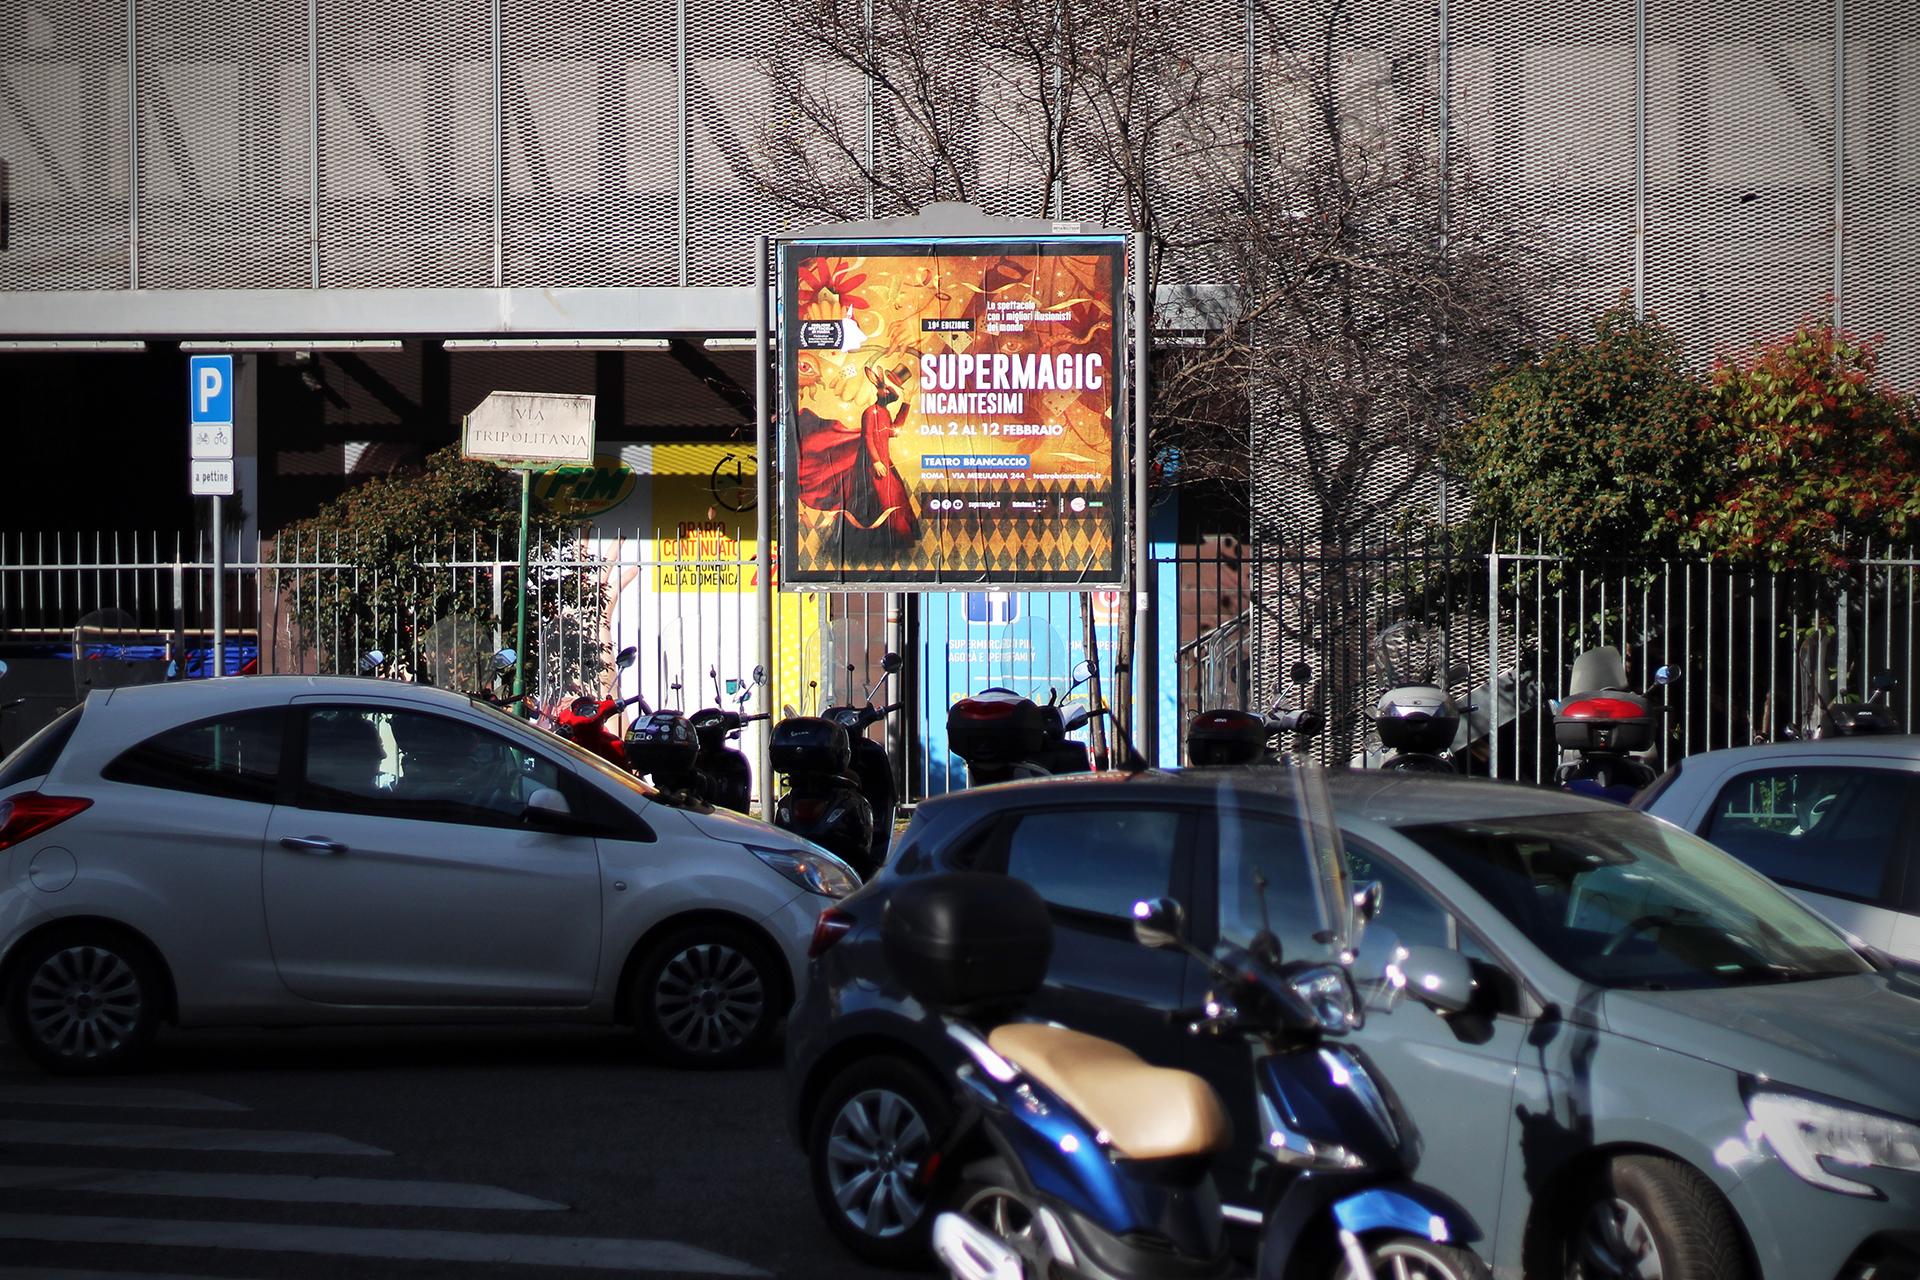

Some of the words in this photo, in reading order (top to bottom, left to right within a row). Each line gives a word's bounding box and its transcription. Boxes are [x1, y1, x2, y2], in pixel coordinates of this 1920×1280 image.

[987, 301, 996, 311] Lo
[997, 301, 1036, 312] spettacolo
[987, 312, 1000, 321] con
[1006, 311, 1034, 323] migliori
[1034, 311, 1072, 321] illusionisti
[941, 320, 970, 330] EDIZIONE
[999, 322, 1024, 332] mondo
[920, 353, 1103, 391] SUPERMAGIC
[200, 367, 223, 413] P
[920, 392, 1024, 415] INCANTESIMI
[515, 408, 545, 421] VIA
[920, 424, 944, 436] DAL
[948, 421, 958, 436] 2
[961, 424, 976, 436] AL
[981, 422, 1000, 436] 12
[1003, 423, 1063, 436] FEBBRAIO
[473, 429, 588, 447] TRIPOLITANIA
[924, 457, 961, 467] TEATRO
[963, 457, 1027, 467] BRANCACCIO
[195, 473, 200, 482] a
[202, 470, 228, 484] pettine
[920, 472, 944, 480] ROMA
[951, 472, 965, 480] VIA
[967, 472, 1010, 480] MERULANA
[1011, 472, 1026, 480] 244
[663, 540, 740, 557] CONTNUATO
